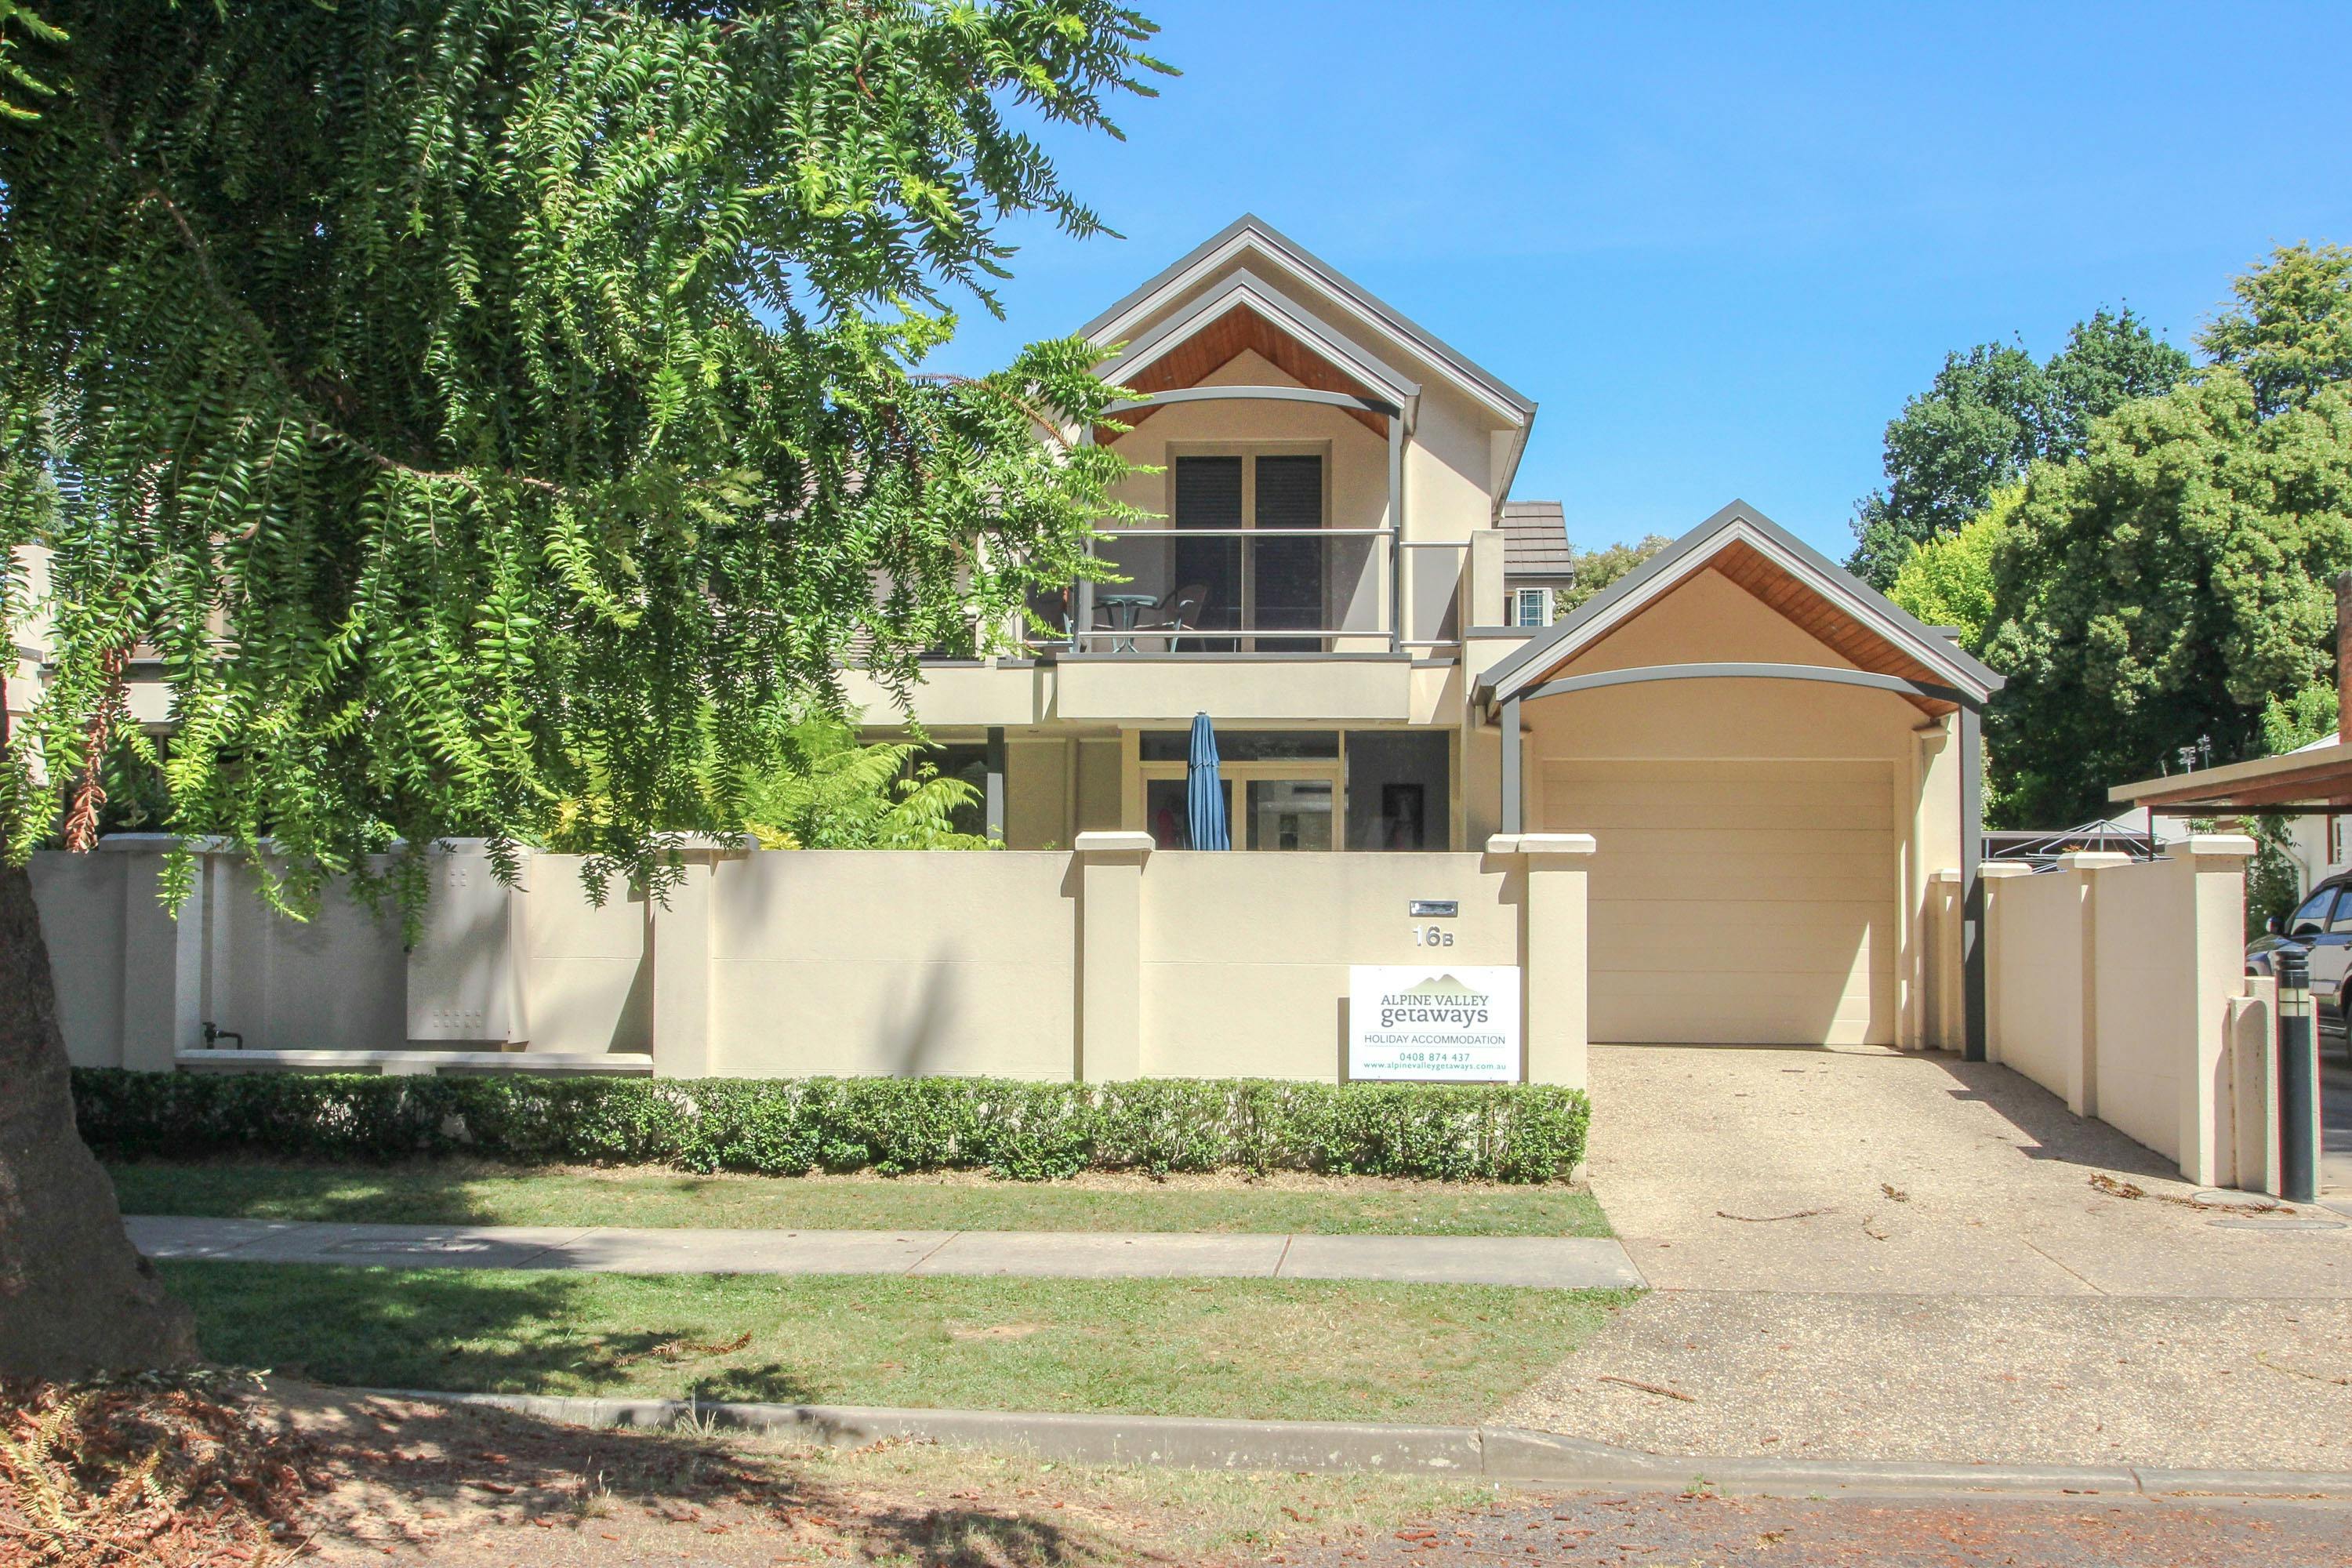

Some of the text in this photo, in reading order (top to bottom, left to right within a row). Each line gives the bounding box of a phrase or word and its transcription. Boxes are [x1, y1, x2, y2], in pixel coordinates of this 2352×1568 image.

[1413, 925, 1454, 947] 16B
[1381, 994, 1489, 1007] ALPINE VALLEY
[1381, 1007, 1489, 1029] getaways
[1364, 1034, 1506, 1045] HOLIDAY ACCOMMODATION
[1399, 1053, 1471, 1062] 0408 874 437
[1363, 1062, 1507, 1071] www.alpinevalleygetaways.com.au
